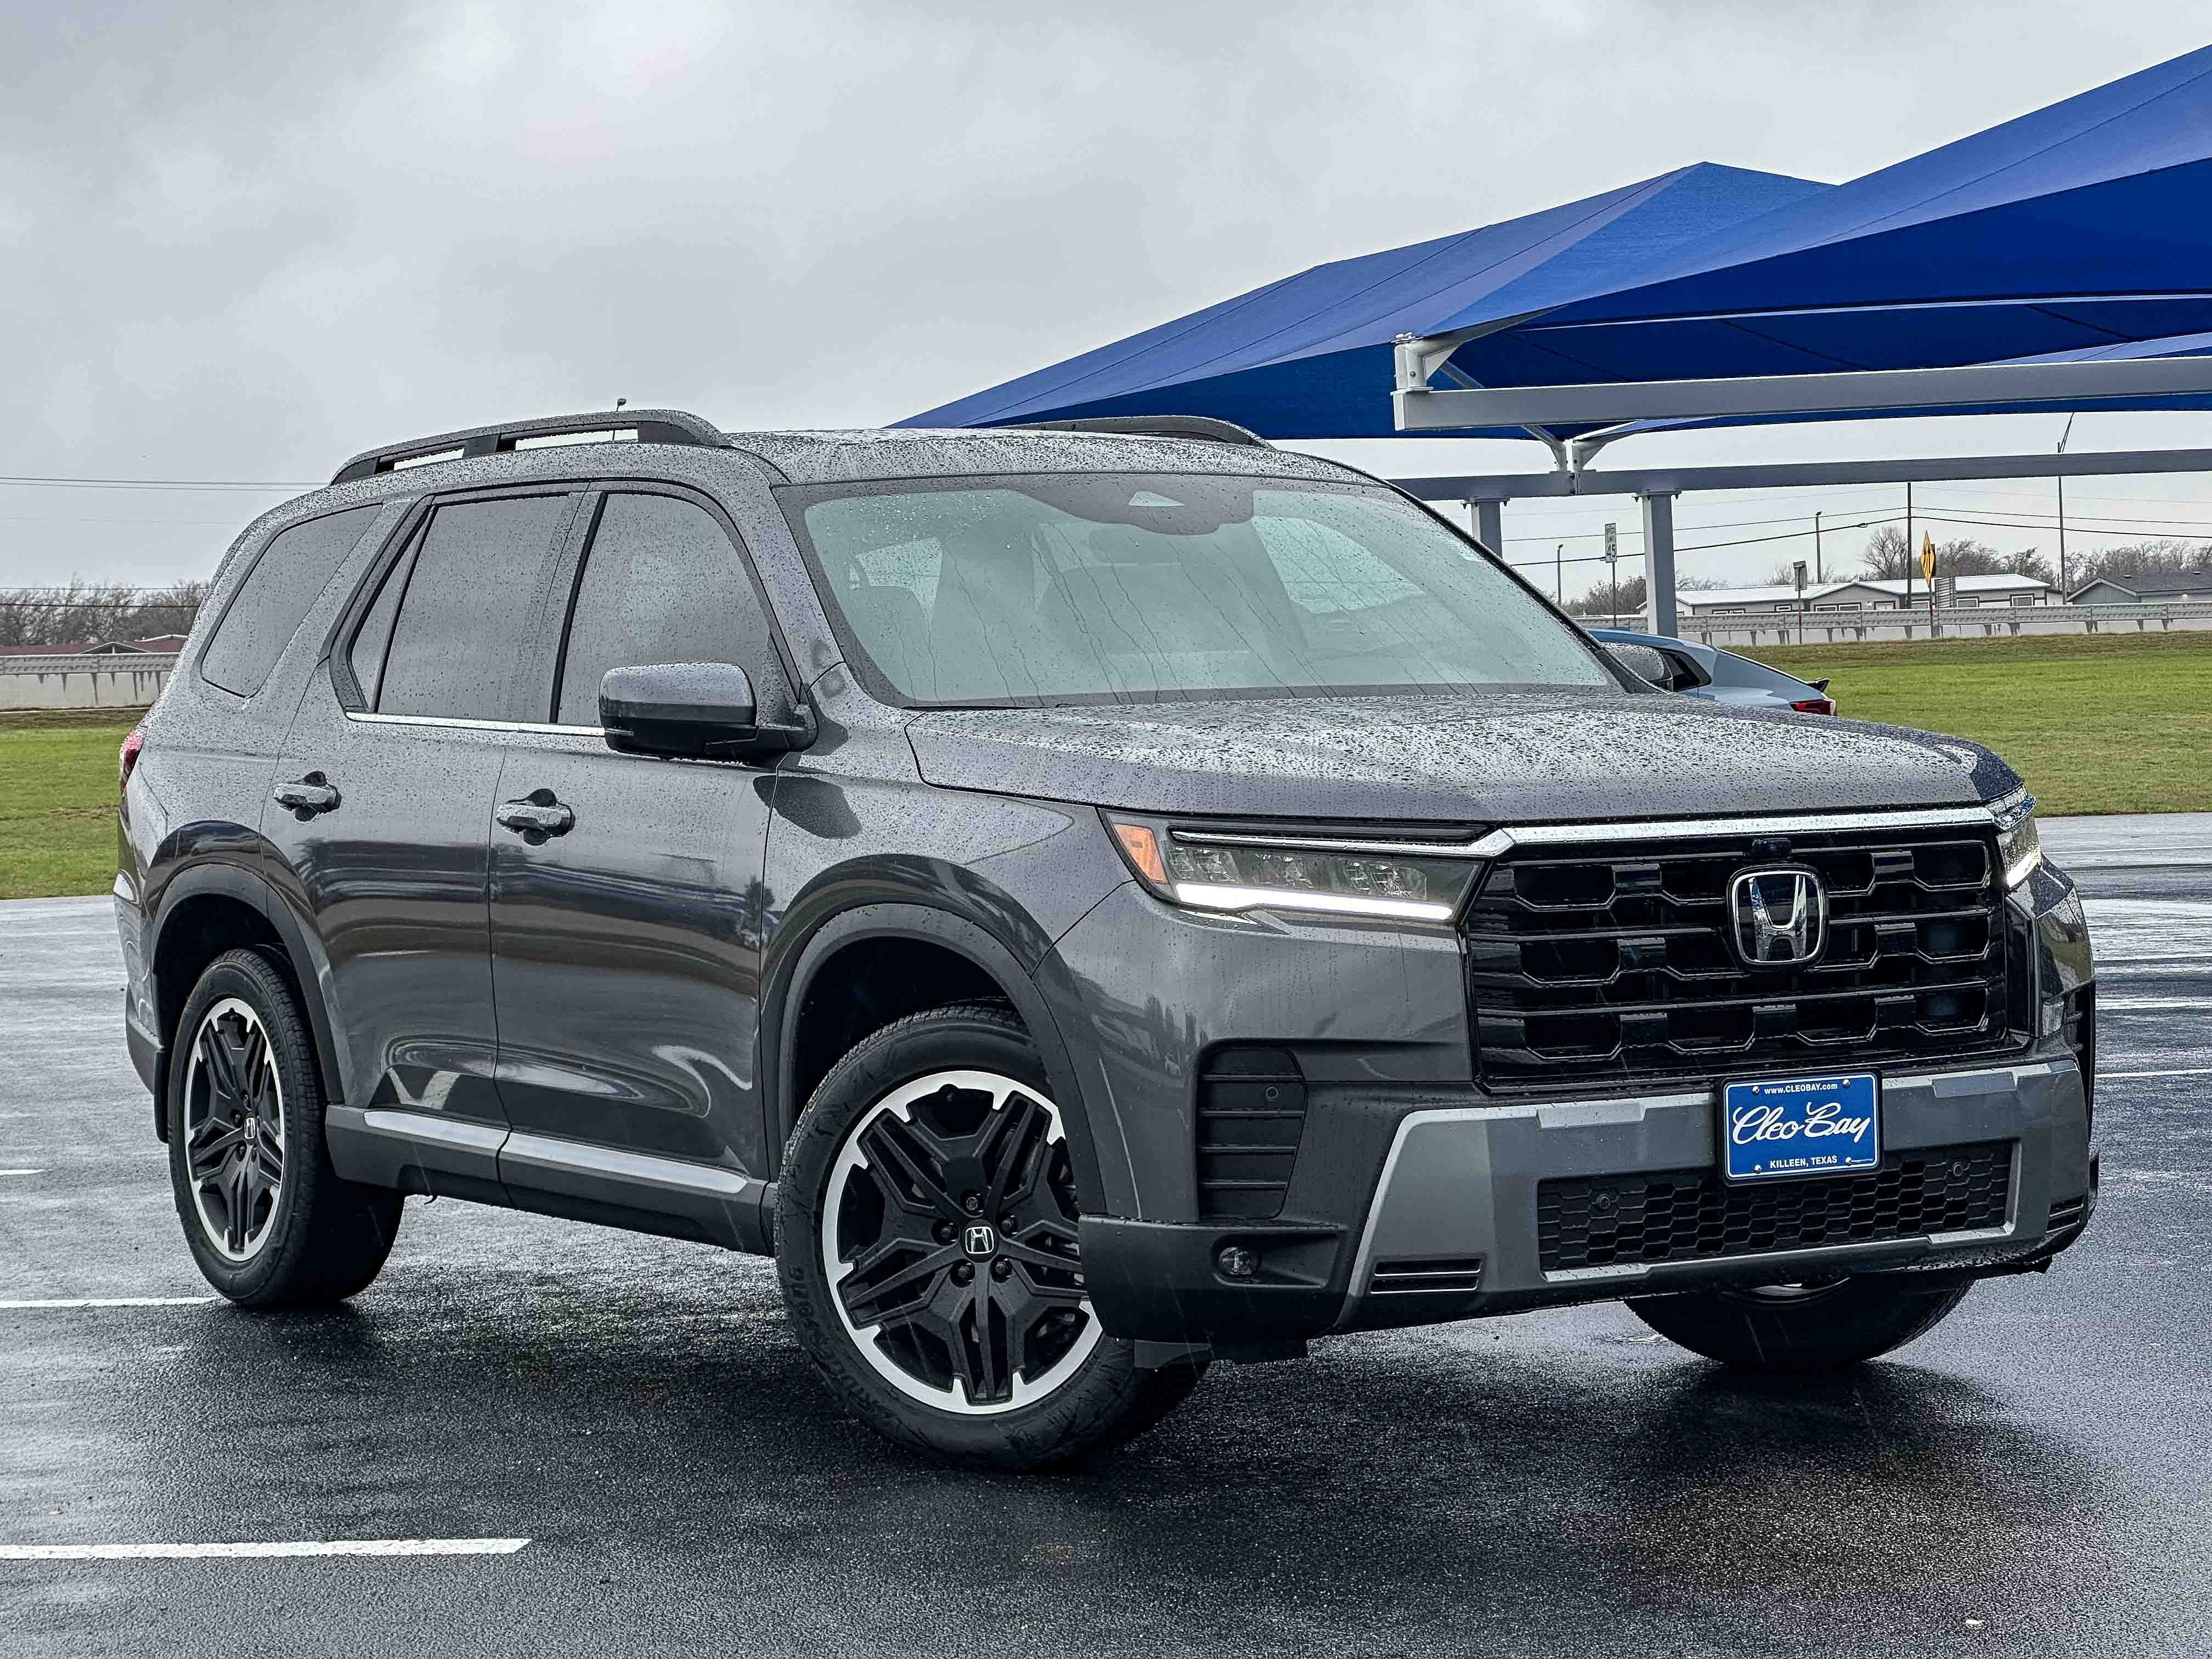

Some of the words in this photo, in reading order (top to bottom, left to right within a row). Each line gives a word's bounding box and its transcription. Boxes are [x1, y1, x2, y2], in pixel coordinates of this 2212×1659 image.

[1607, 544, 1616, 558] 45
[1764, 1083, 1838, 1094] www.CLEOBAY.com
[1733, 1105, 1804, 1144] Cleo
[1804, 1102, 1871, 1143] Bay
[1769, 1158, 1809, 1169] KILLEEN,
[1810, 1155, 1838, 1165] TEXAS
